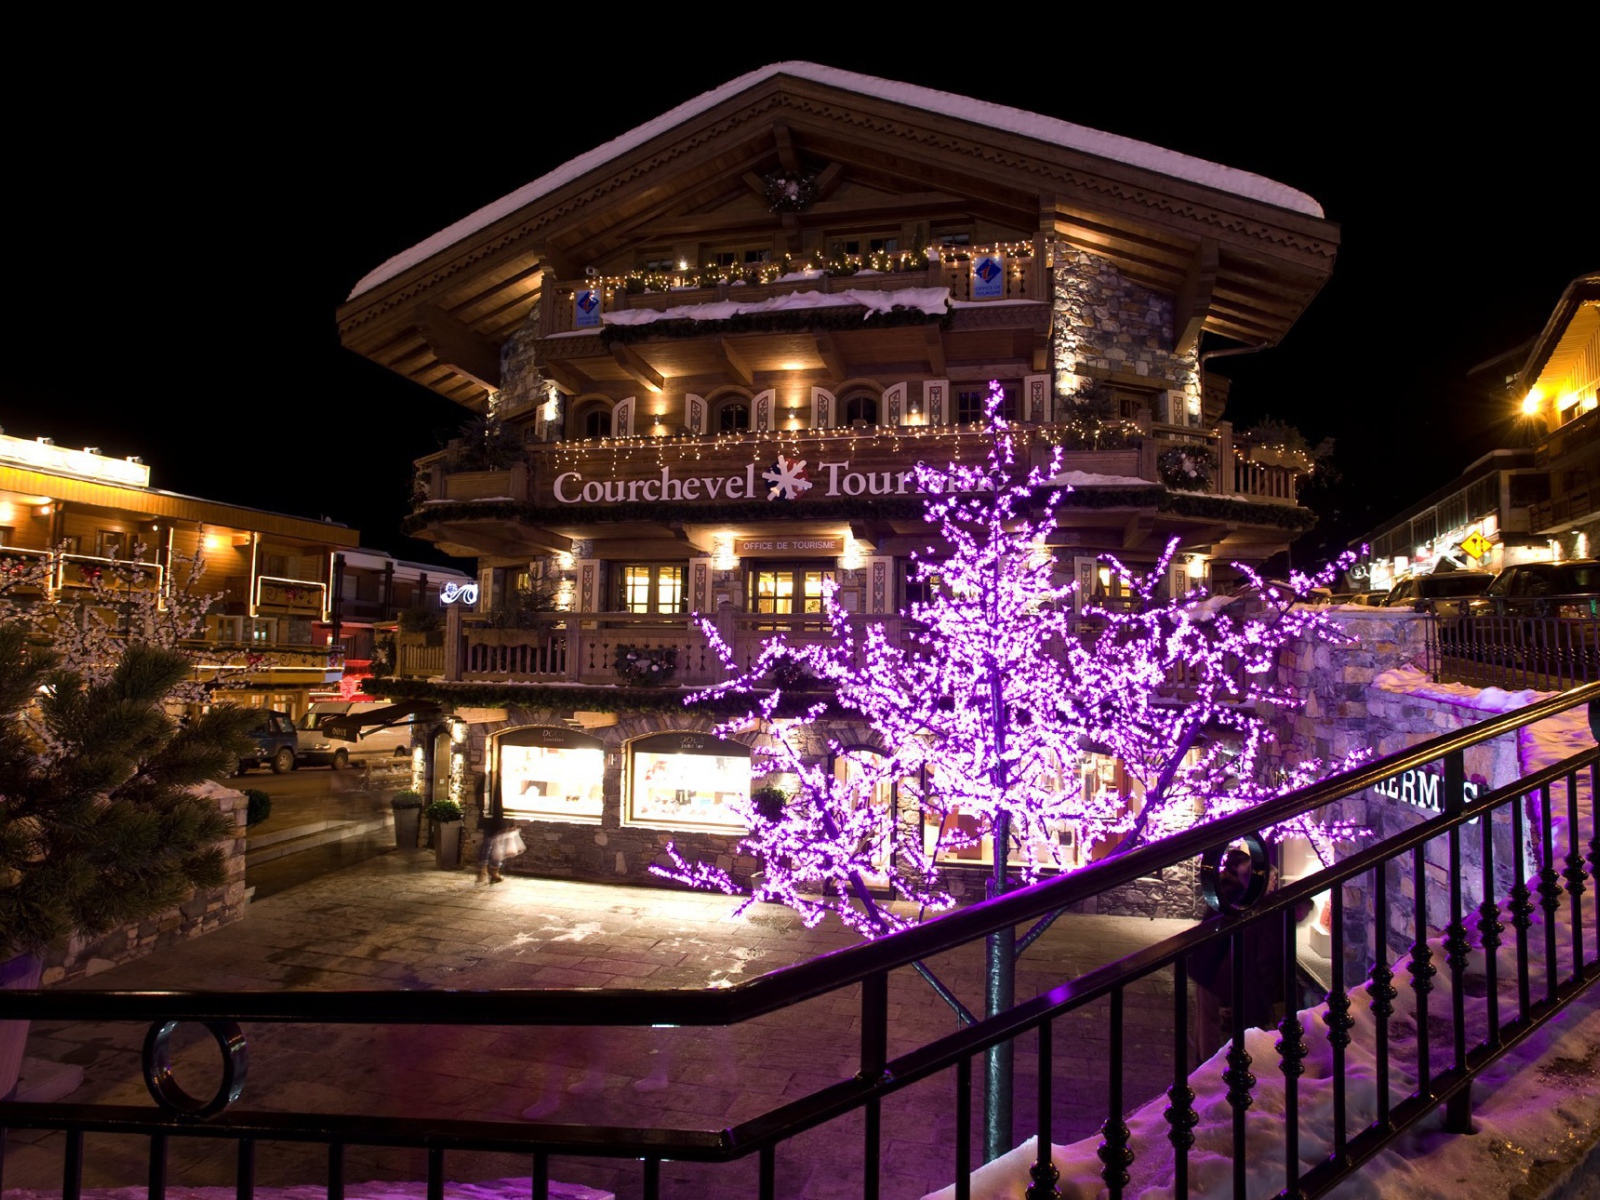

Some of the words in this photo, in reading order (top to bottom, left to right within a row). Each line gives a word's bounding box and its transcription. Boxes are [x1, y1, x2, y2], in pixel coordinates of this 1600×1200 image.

[553, 463, 756, 503] Courchevel
[818, 460, 1006, 497] Tourme
[743, 542, 772, 550] OFFICE
[776, 541, 788, 549] DE
[793, 541, 836, 549] TOURISME
[1374, 769, 1479, 825] ERMS
